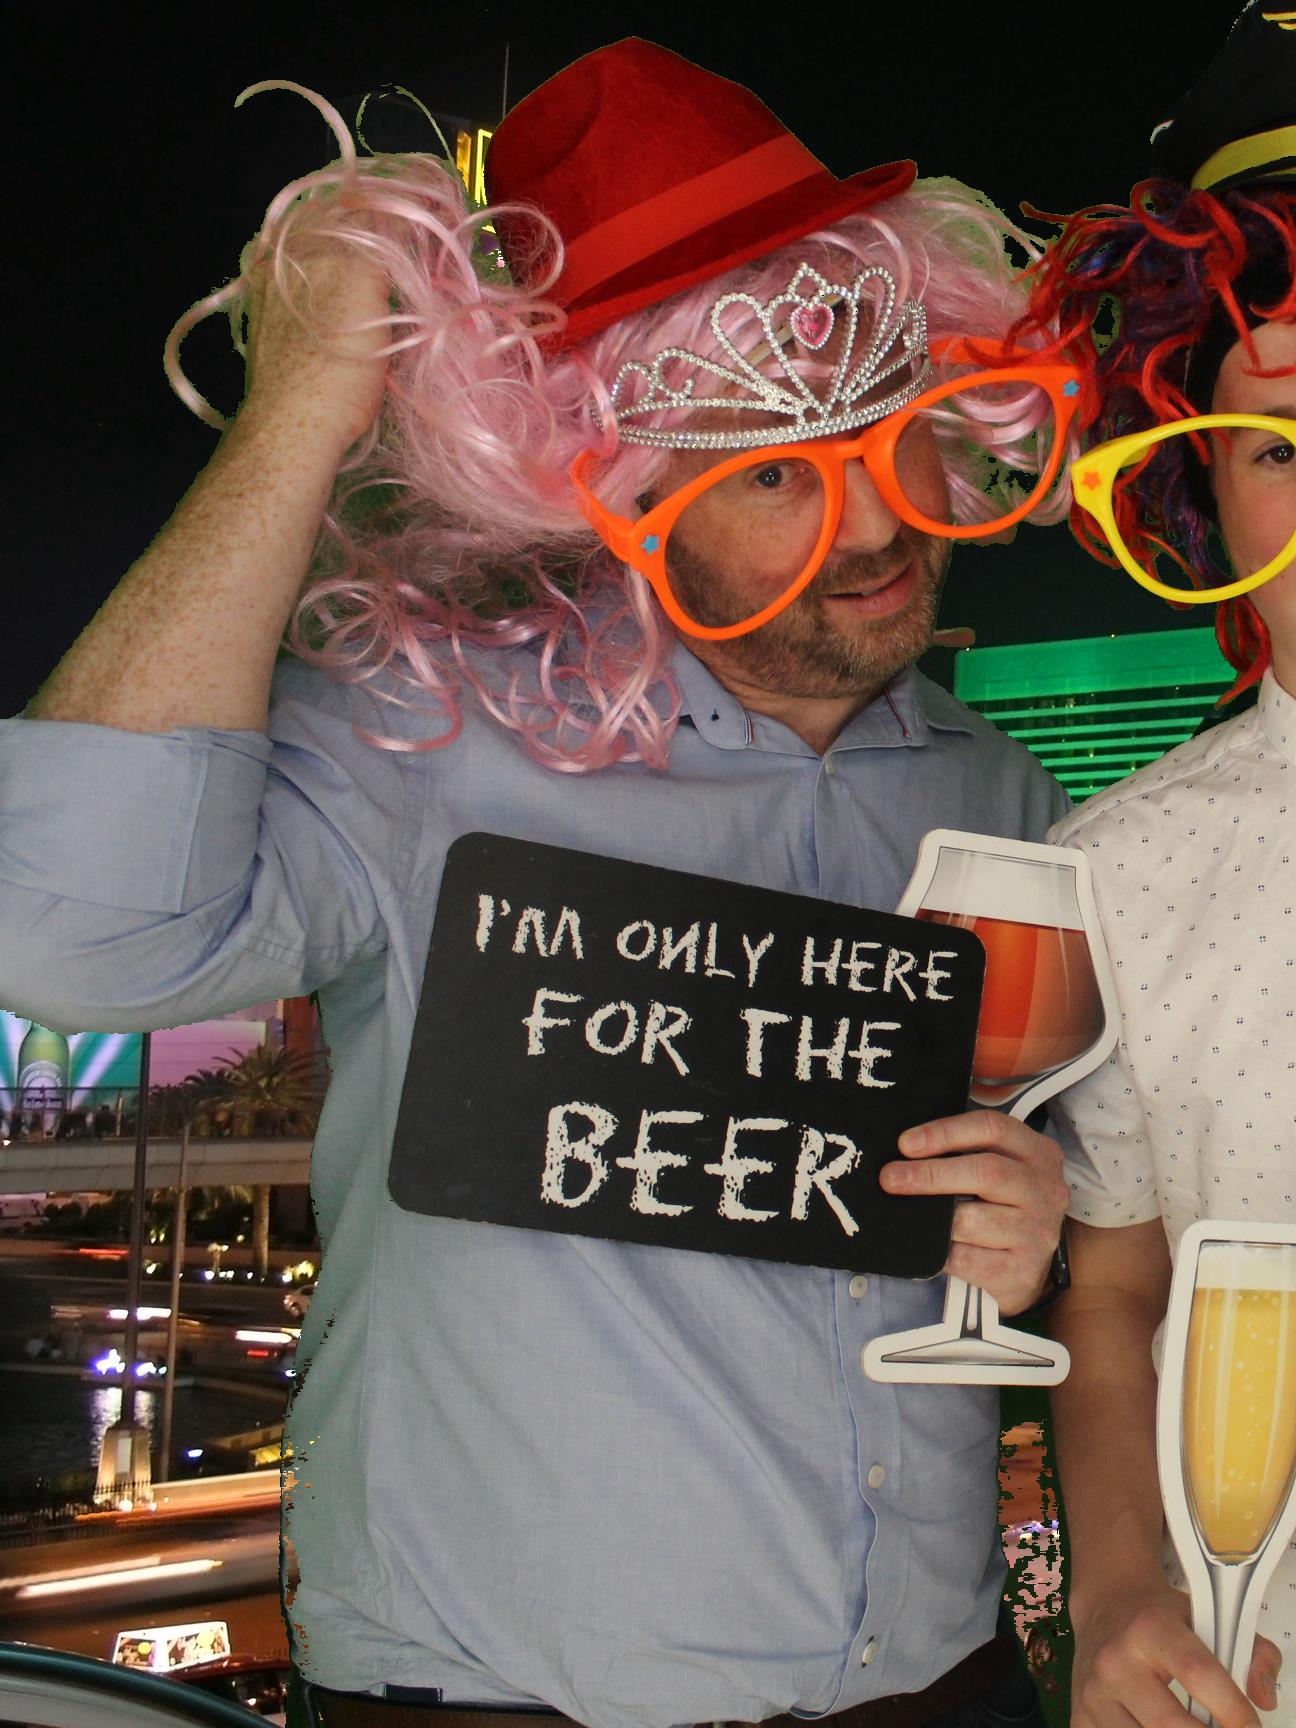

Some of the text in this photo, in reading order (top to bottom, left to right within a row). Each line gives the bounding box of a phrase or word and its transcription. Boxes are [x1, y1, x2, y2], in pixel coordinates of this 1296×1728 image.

[475, 893, 959, 1002] I'M ONLY HERE
[521, 986, 902, 1089] FOR THE
[540, 1101, 863, 1237] BEER
